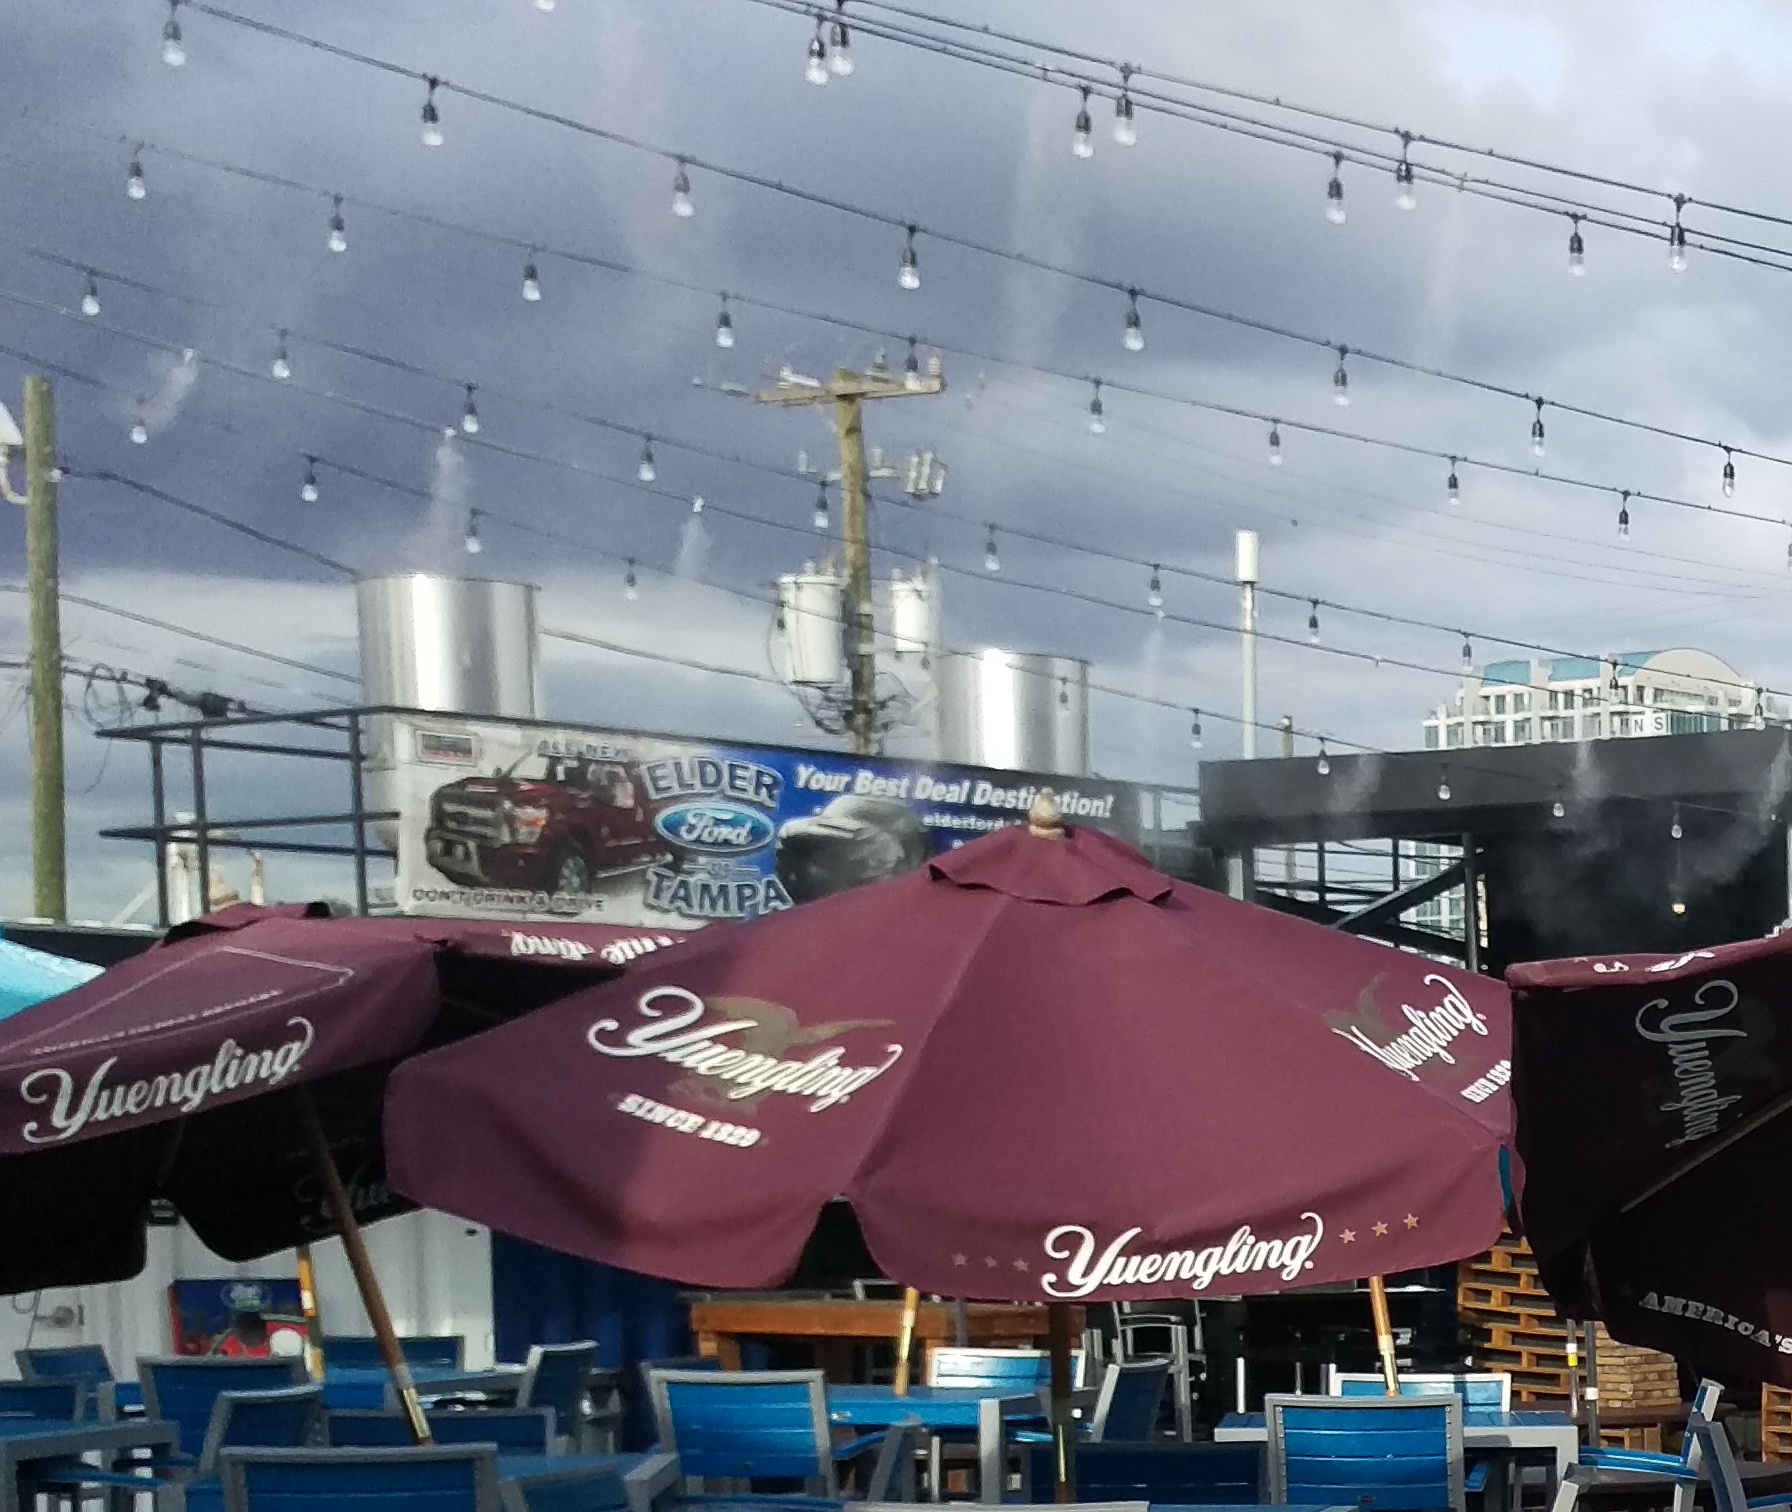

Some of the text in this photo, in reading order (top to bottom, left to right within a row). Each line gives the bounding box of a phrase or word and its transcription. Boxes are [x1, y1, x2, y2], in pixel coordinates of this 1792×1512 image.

[642, 758, 782, 806] ELDER
[795, 763, 1115, 818] Your Best Deal Destition!
[679, 807, 754, 846] Ford
[645, 867, 791, 916] TAMPA
[587, 986, 903, 1113] Yuengling
[20, 1016, 316, 1144] Yuengling
[615, 1093, 705, 1134] SINCE
[1041, 1211, 1324, 1298] Yuengling
